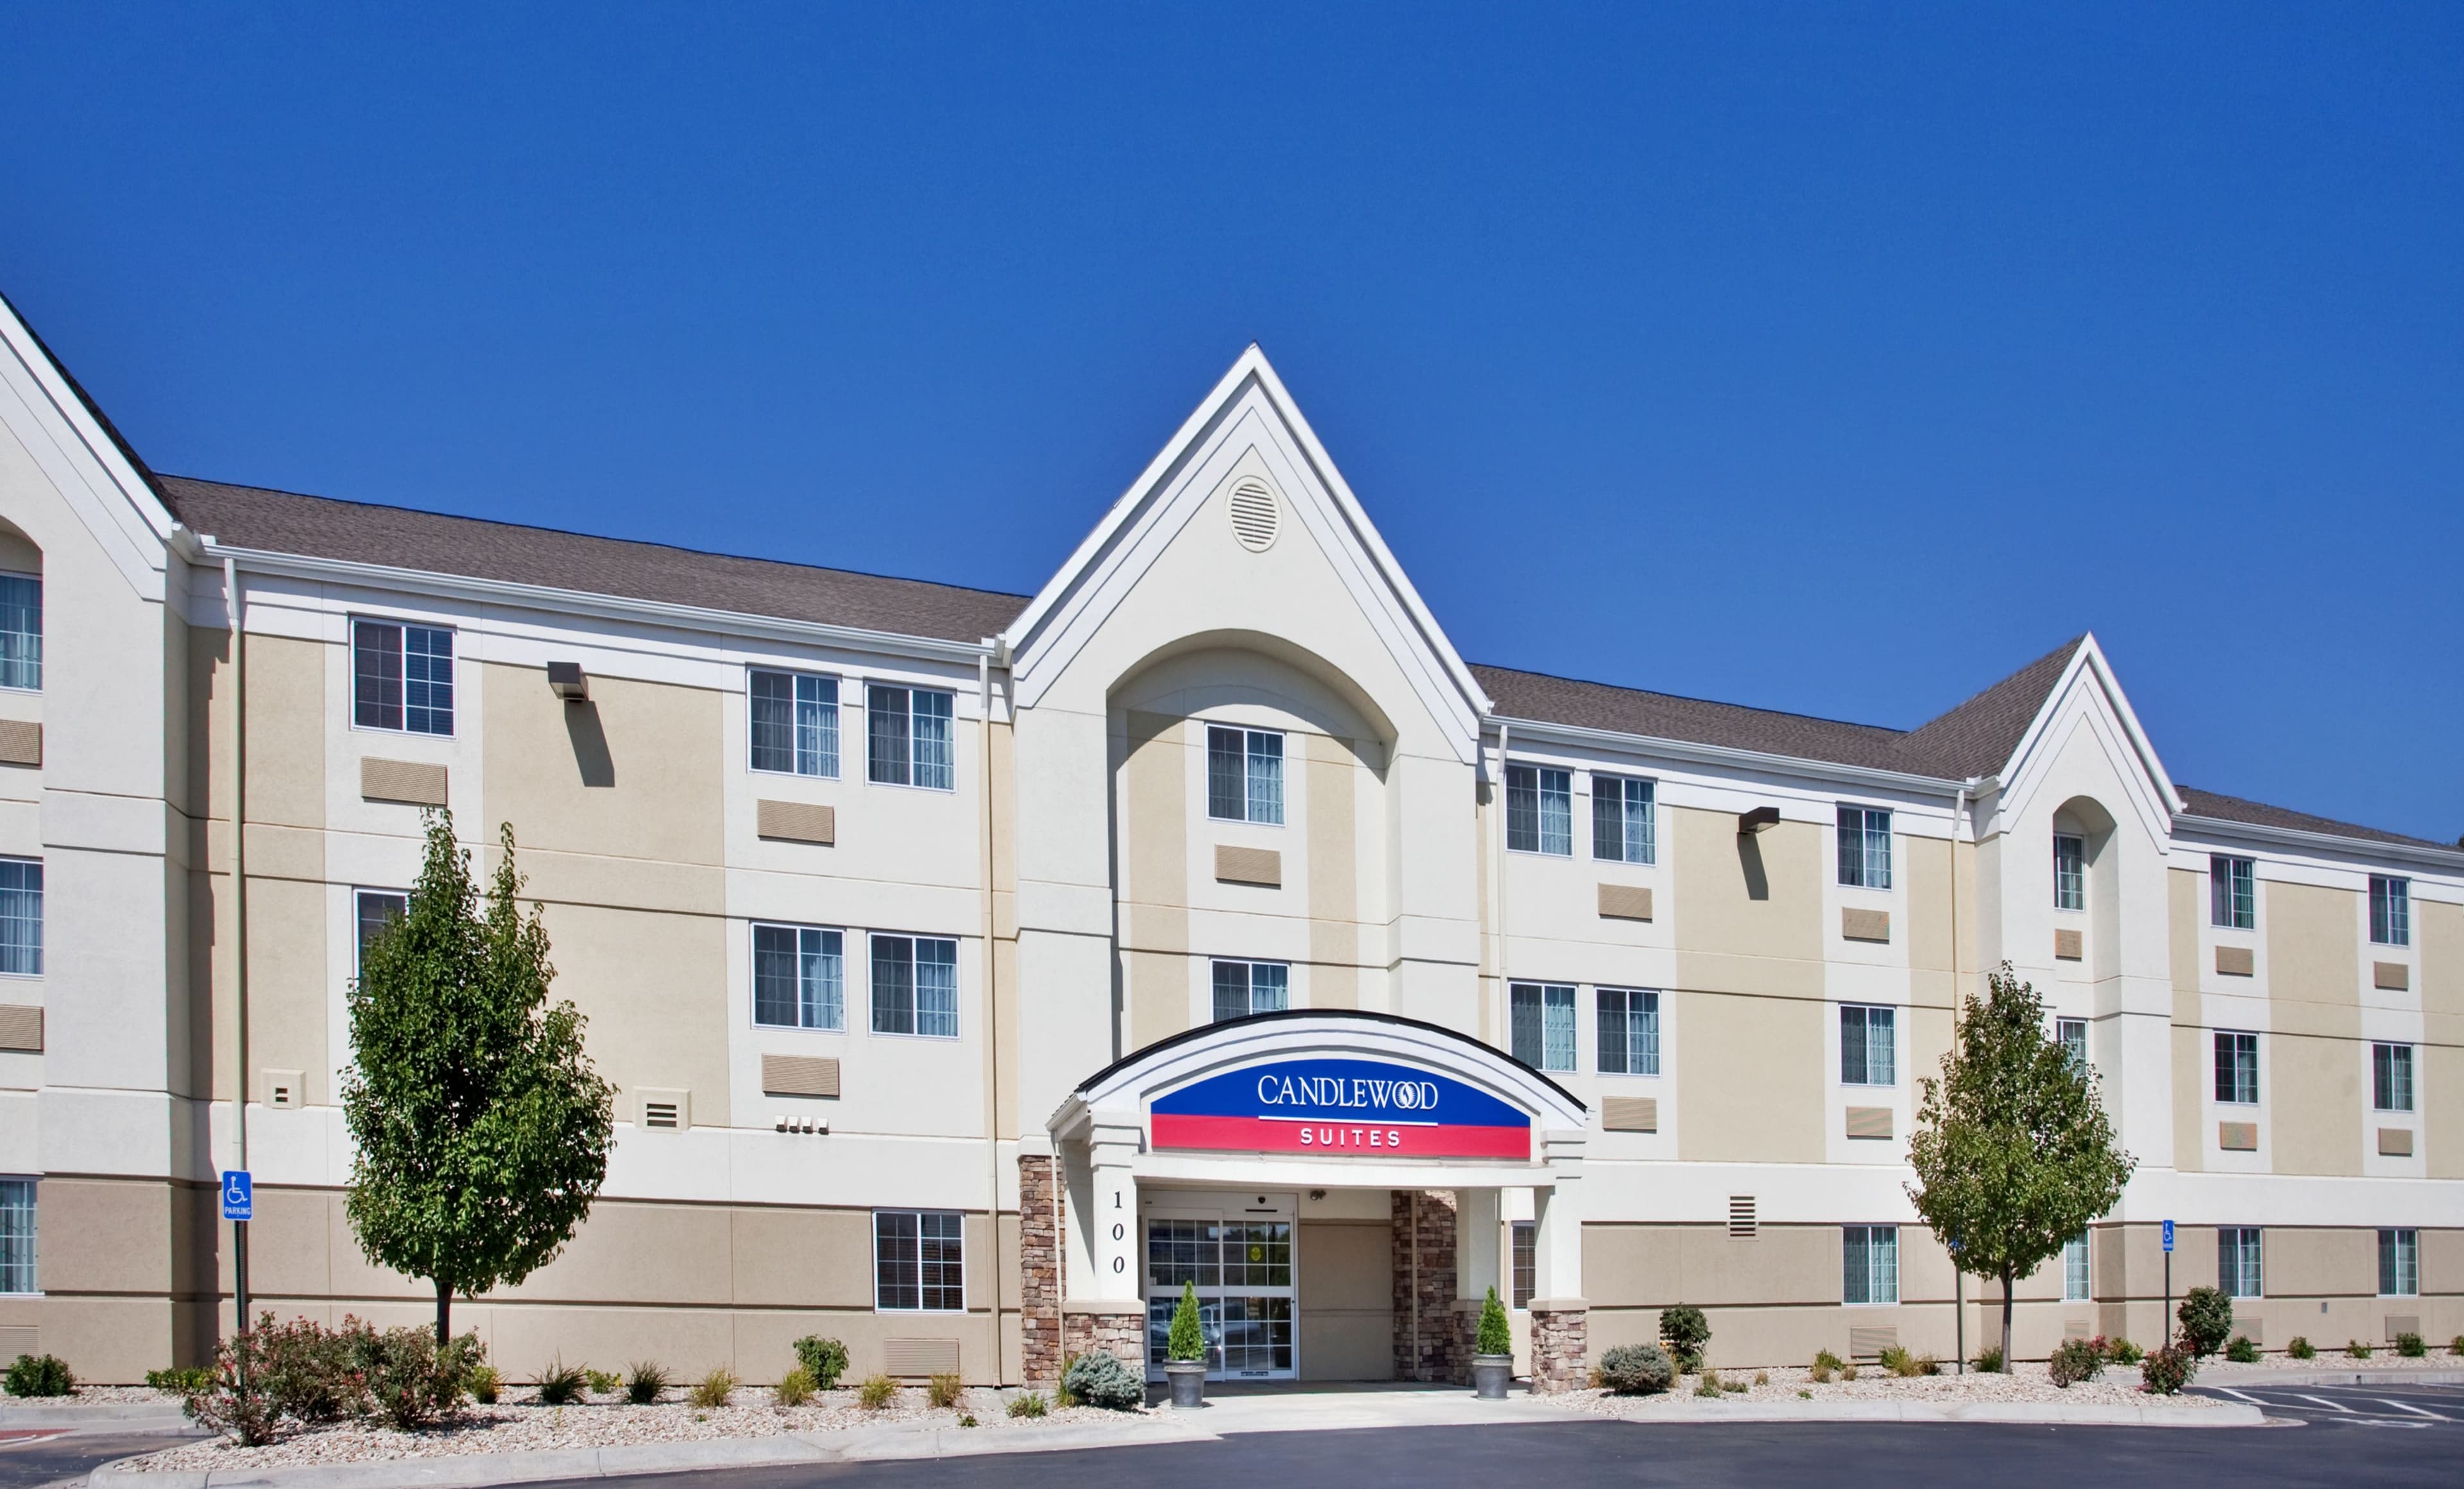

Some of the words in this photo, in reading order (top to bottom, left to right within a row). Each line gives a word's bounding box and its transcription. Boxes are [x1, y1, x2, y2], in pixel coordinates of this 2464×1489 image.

[1258, 1075, 1439, 1110] CANDLEWOOD
[1301, 1128, 1400, 1147] SUITES
[225, 1206, 252, 1215] PARKING
[1113, 1191, 1125, 1273] 100
